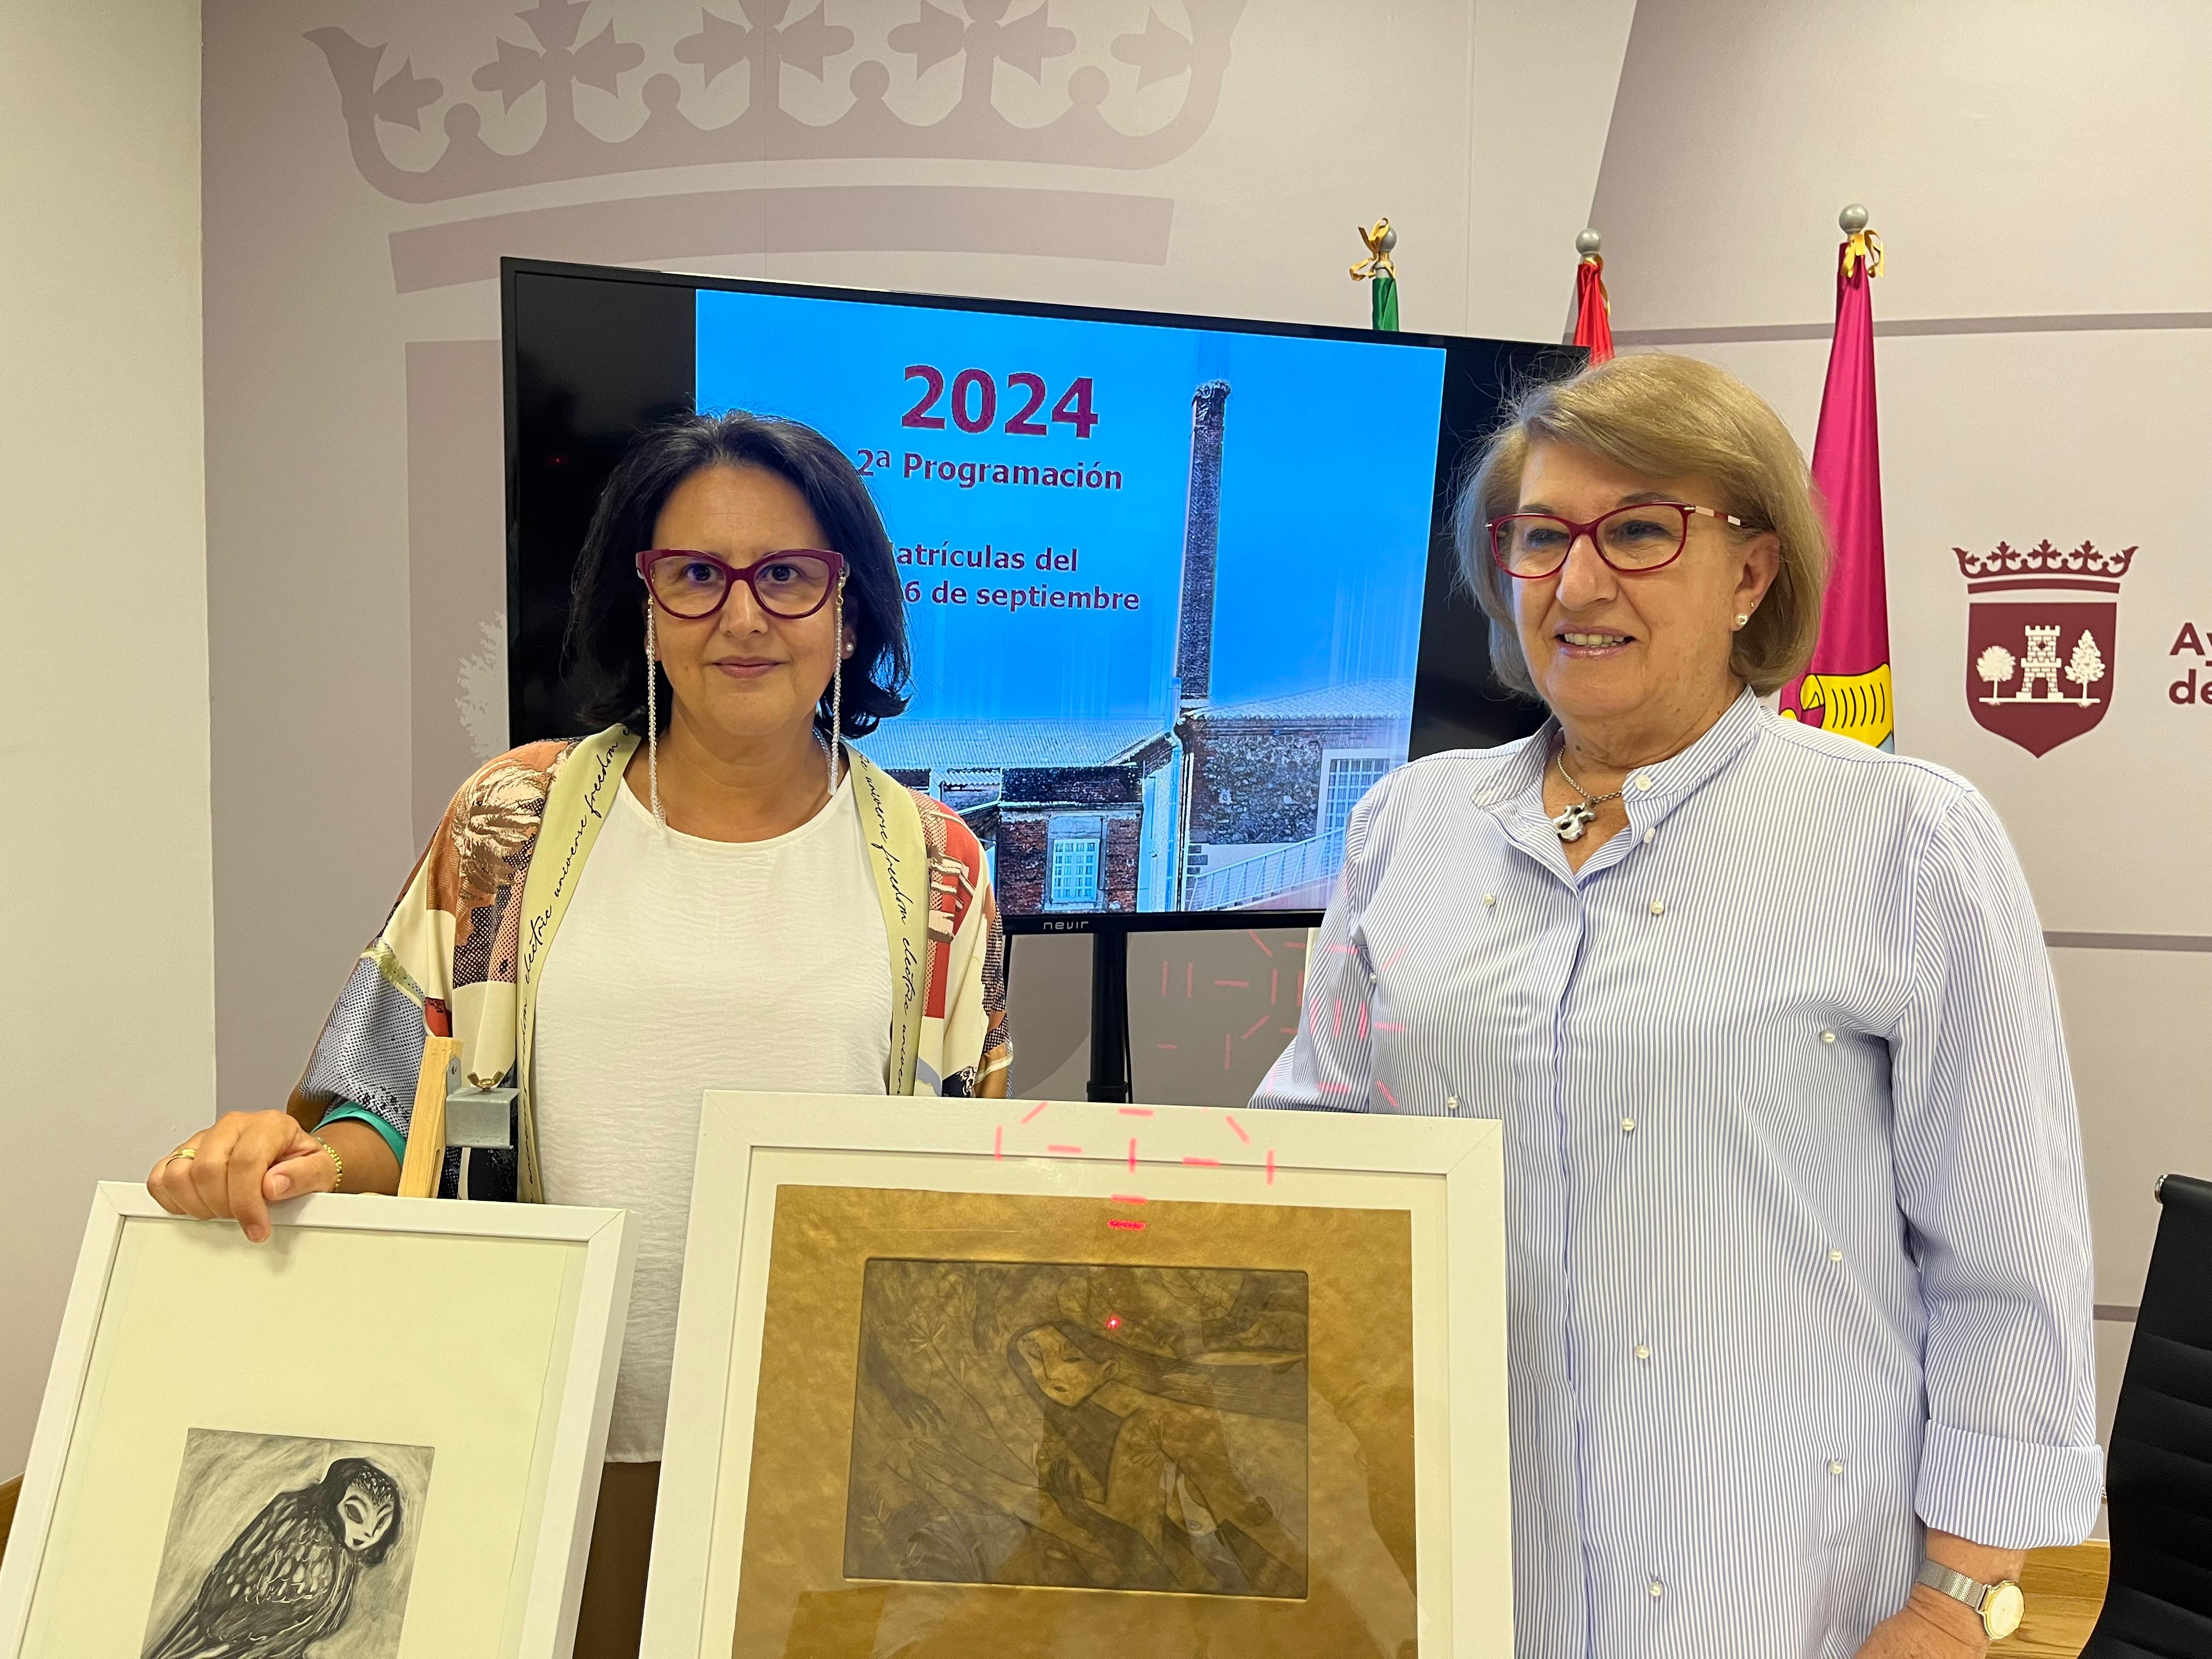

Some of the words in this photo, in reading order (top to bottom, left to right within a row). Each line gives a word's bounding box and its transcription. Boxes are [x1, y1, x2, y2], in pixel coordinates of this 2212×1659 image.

[901, 365, 1099, 439] 2024
[904, 453, 1122, 490] Programación
[896, 541, 1025, 569] atrículas
[1035, 547, 1077, 572] del
[932, 580, 967, 604] de
[977, 584, 1139, 612] septiembre
[2169, 622, 2212, 667] A
[865, 776, 888, 844] universe
[523, 904, 552, 984] electric
[554, 814, 587, 898] universe
[584, 742, 618, 819] freedom
[871, 842, 914, 926] freedom
[1043, 921, 1089, 930] nevir
[902, 937, 917, 1015] electric
[897, 1024, 906, 1096] univers
